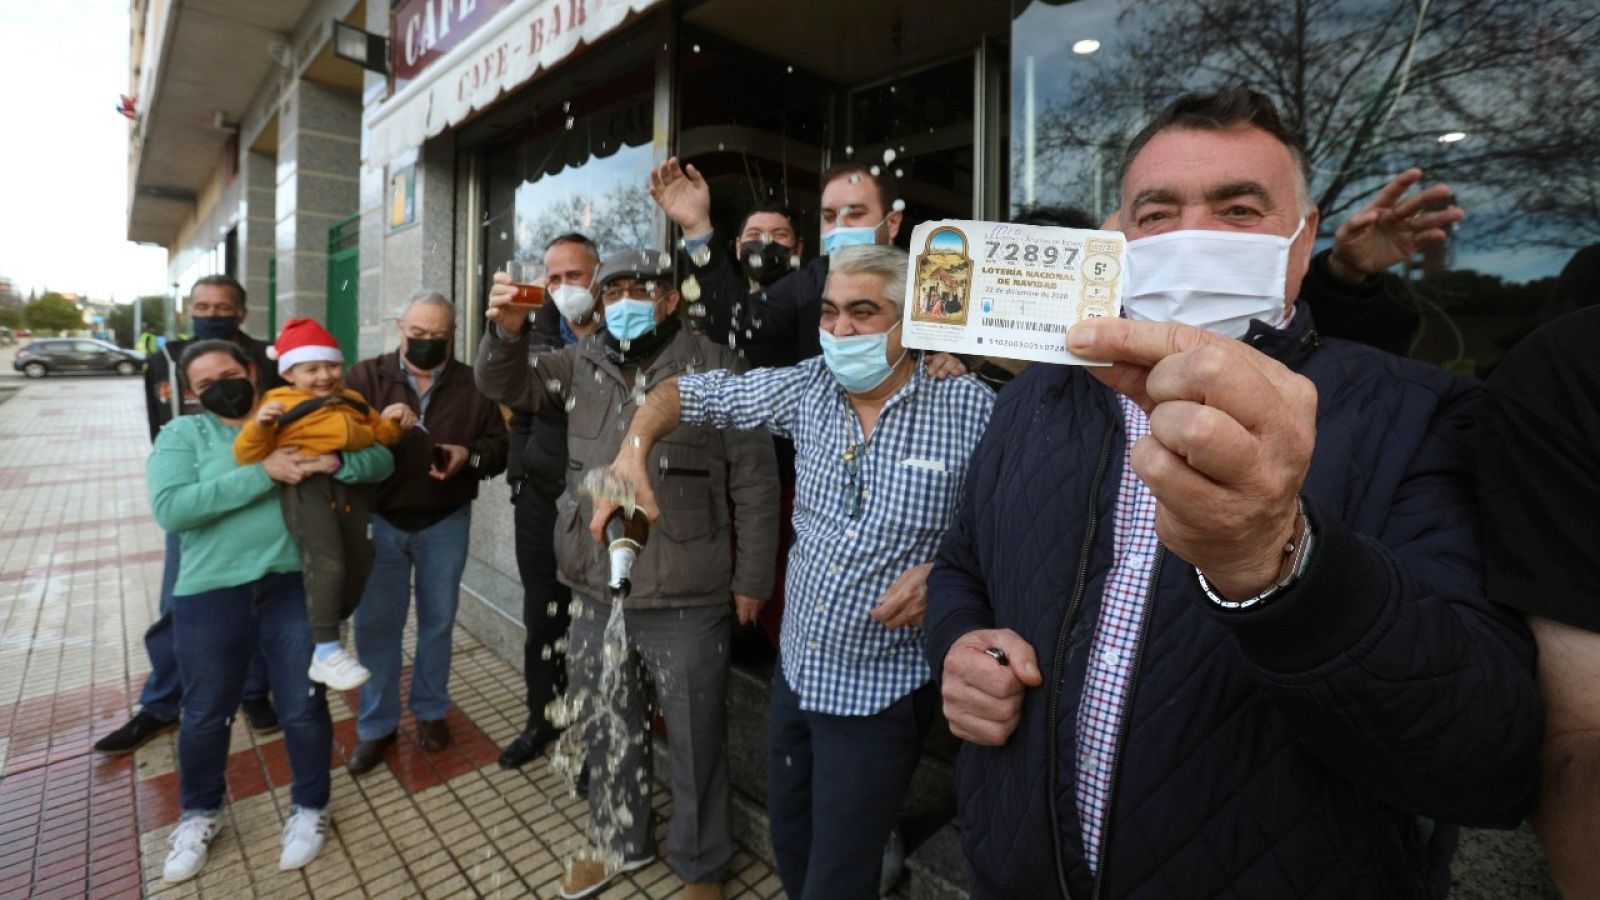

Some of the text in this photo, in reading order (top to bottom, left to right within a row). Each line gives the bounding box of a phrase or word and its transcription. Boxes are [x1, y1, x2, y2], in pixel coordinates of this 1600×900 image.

[985, 241, 1079, 265] 72897
[982, 267, 1076, 281] LOTERÍA NACIONAL
[997, 278, 1058, 289] DE NAVIDAD
